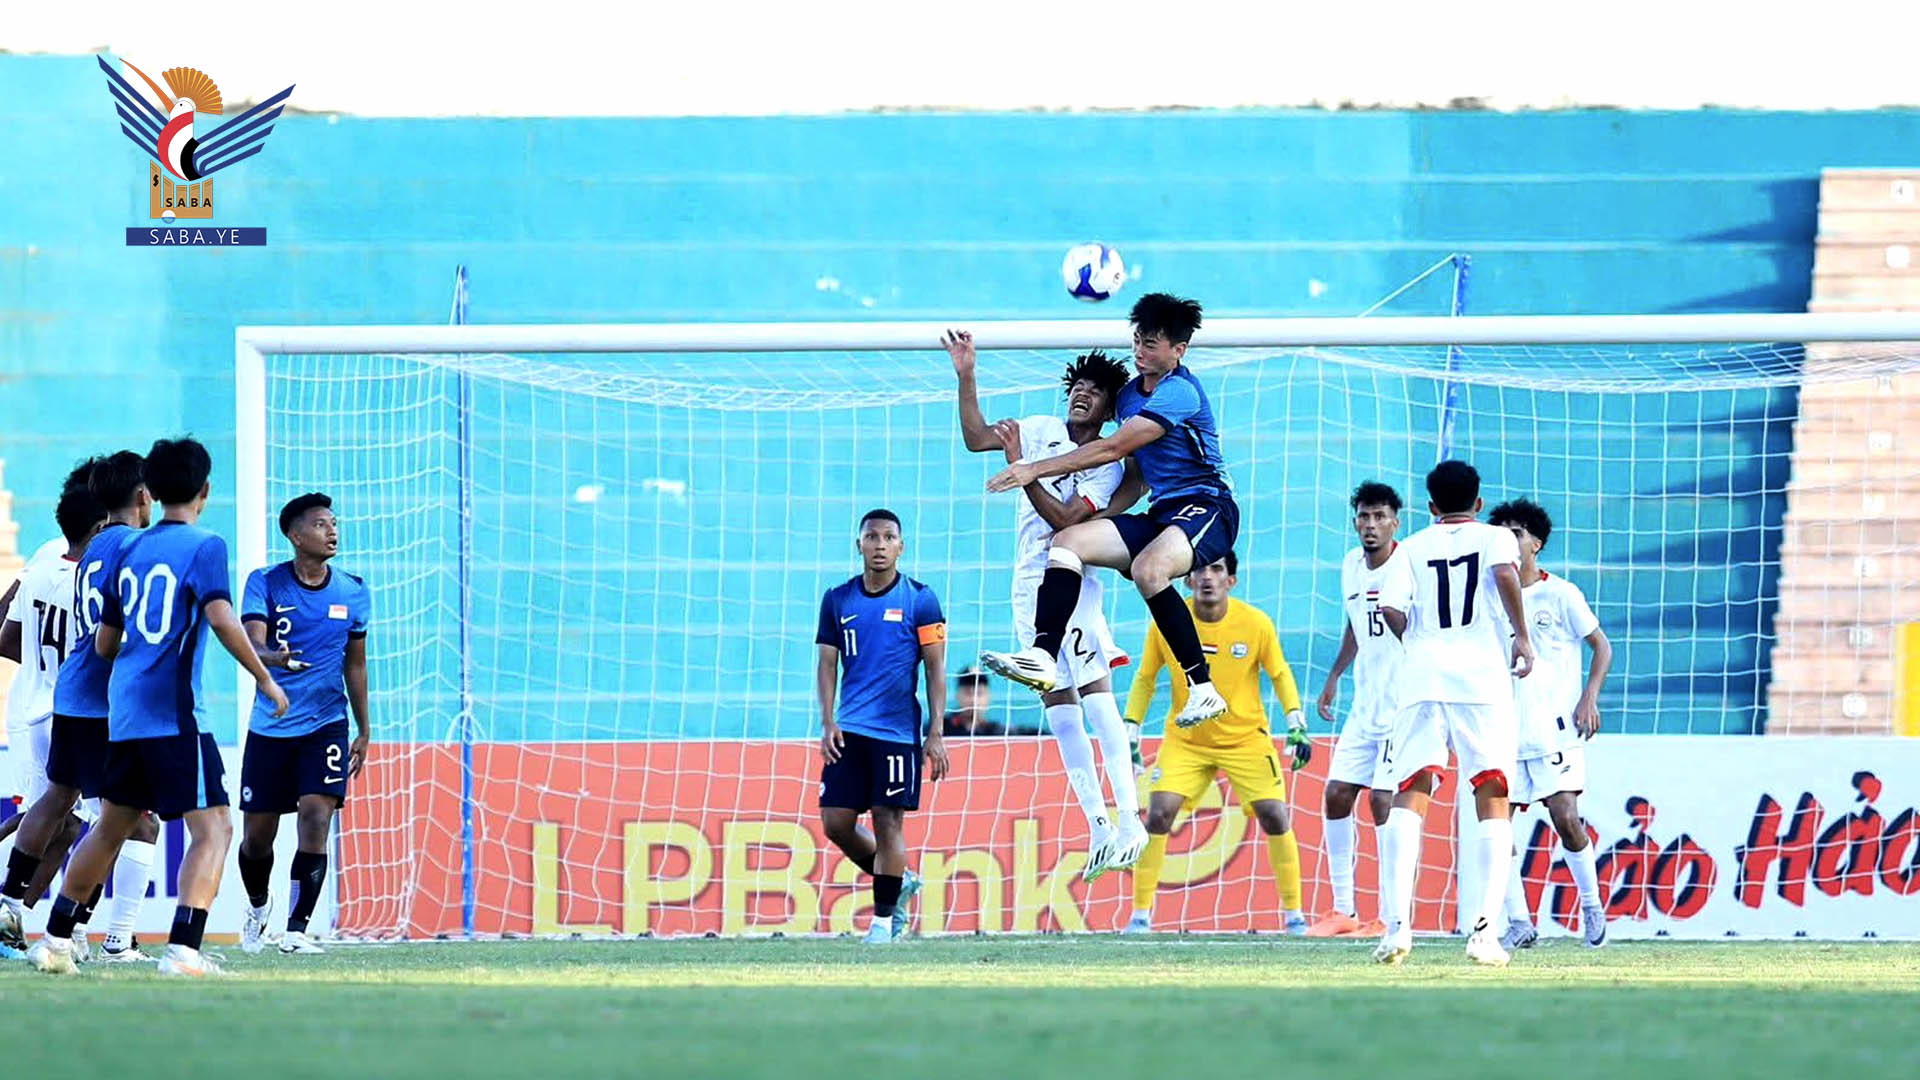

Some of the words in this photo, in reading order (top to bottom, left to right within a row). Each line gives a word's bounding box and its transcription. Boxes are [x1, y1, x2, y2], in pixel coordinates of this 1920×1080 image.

[118, 563, 178, 645] 20
[1427, 552, 1480, 629] 17
[33, 599, 68, 672] 14
[1366, 611, 1384, 637] 15
[843, 629, 858, 656] 11
[1071, 627, 1087, 656] 2
[325, 743, 342, 771] 2
[886, 755, 904, 783] 11
[1266, 755, 1277, 778] 1
